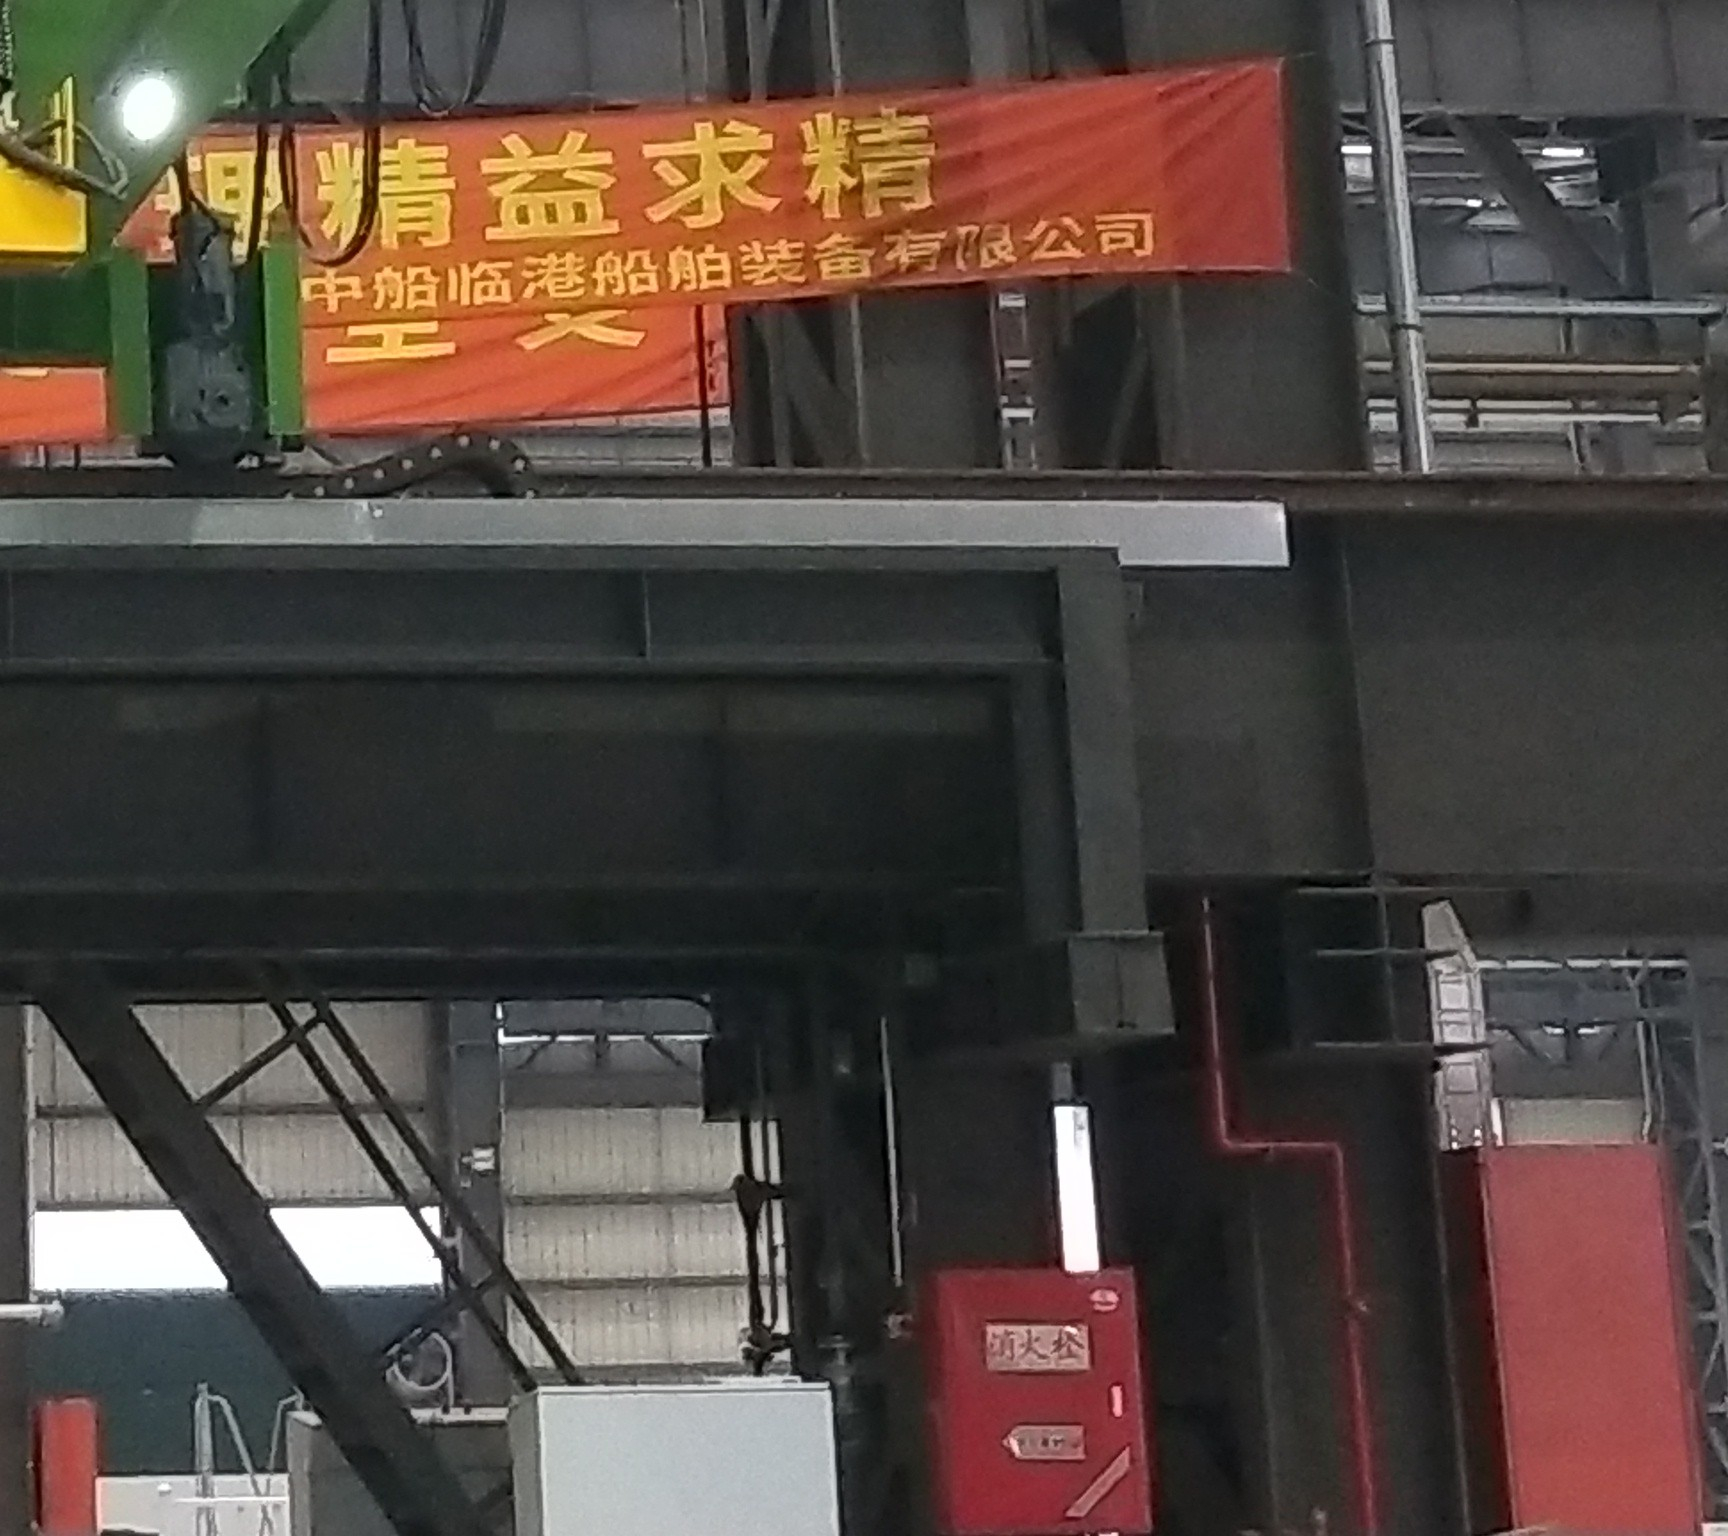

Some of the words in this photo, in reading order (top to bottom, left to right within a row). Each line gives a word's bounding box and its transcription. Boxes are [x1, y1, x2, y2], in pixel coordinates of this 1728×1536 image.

[302, 211, 1157, 314] 中船临港船舶装备有限公司
